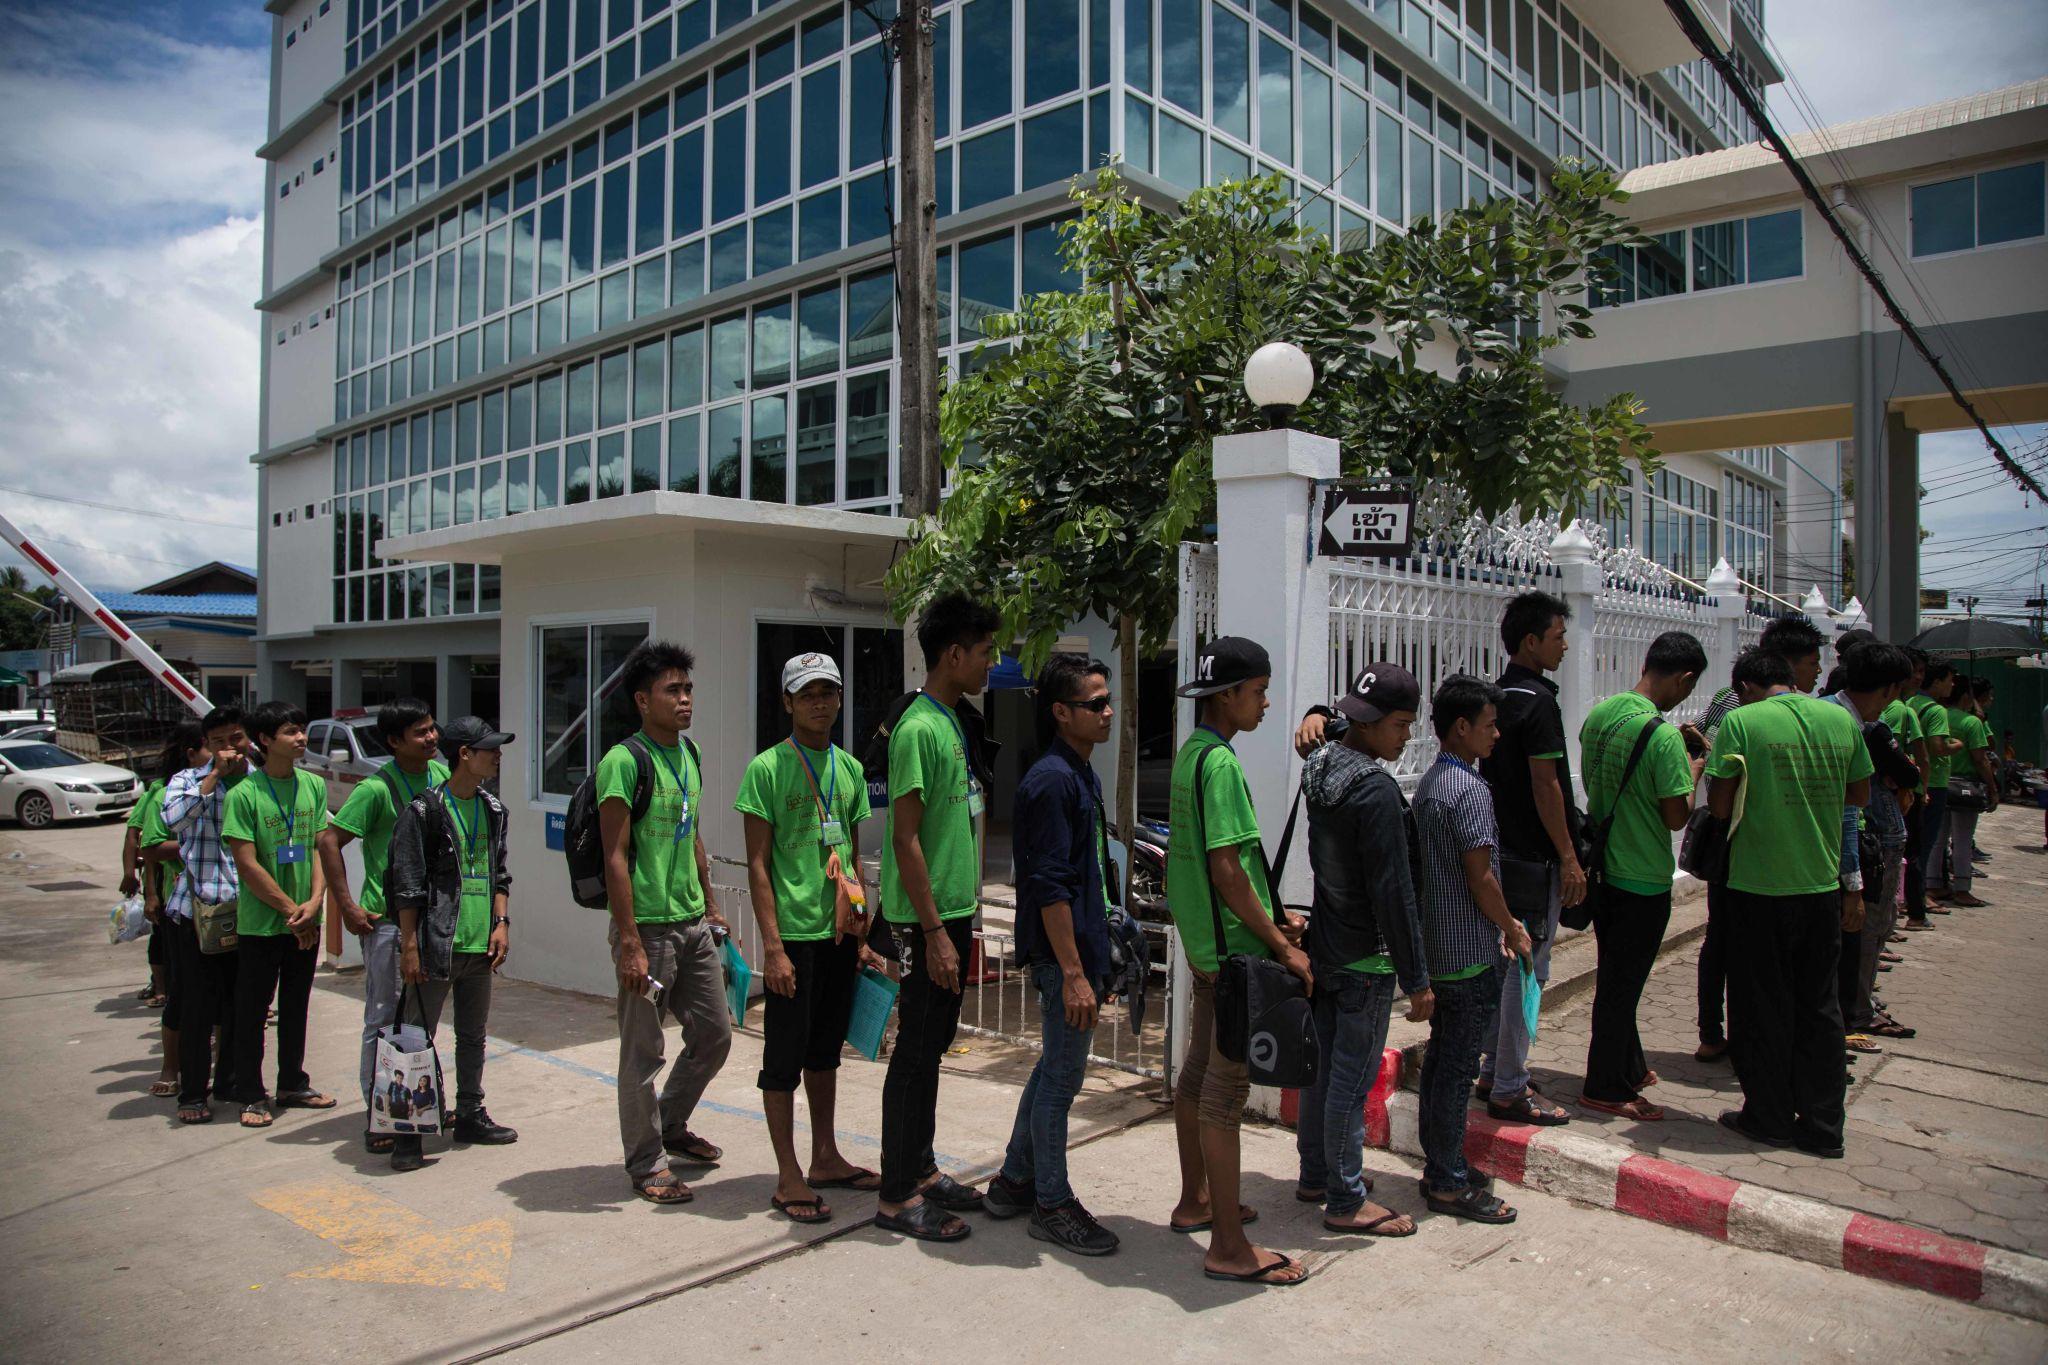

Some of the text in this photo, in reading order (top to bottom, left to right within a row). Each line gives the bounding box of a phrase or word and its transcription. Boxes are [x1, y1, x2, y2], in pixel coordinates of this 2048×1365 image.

[1352, 506, 1397, 527] เข้า
[1353, 528, 1392, 541] IN
[1198, 655, 1215, 681] M
[1358, 672, 1376, 694] C
